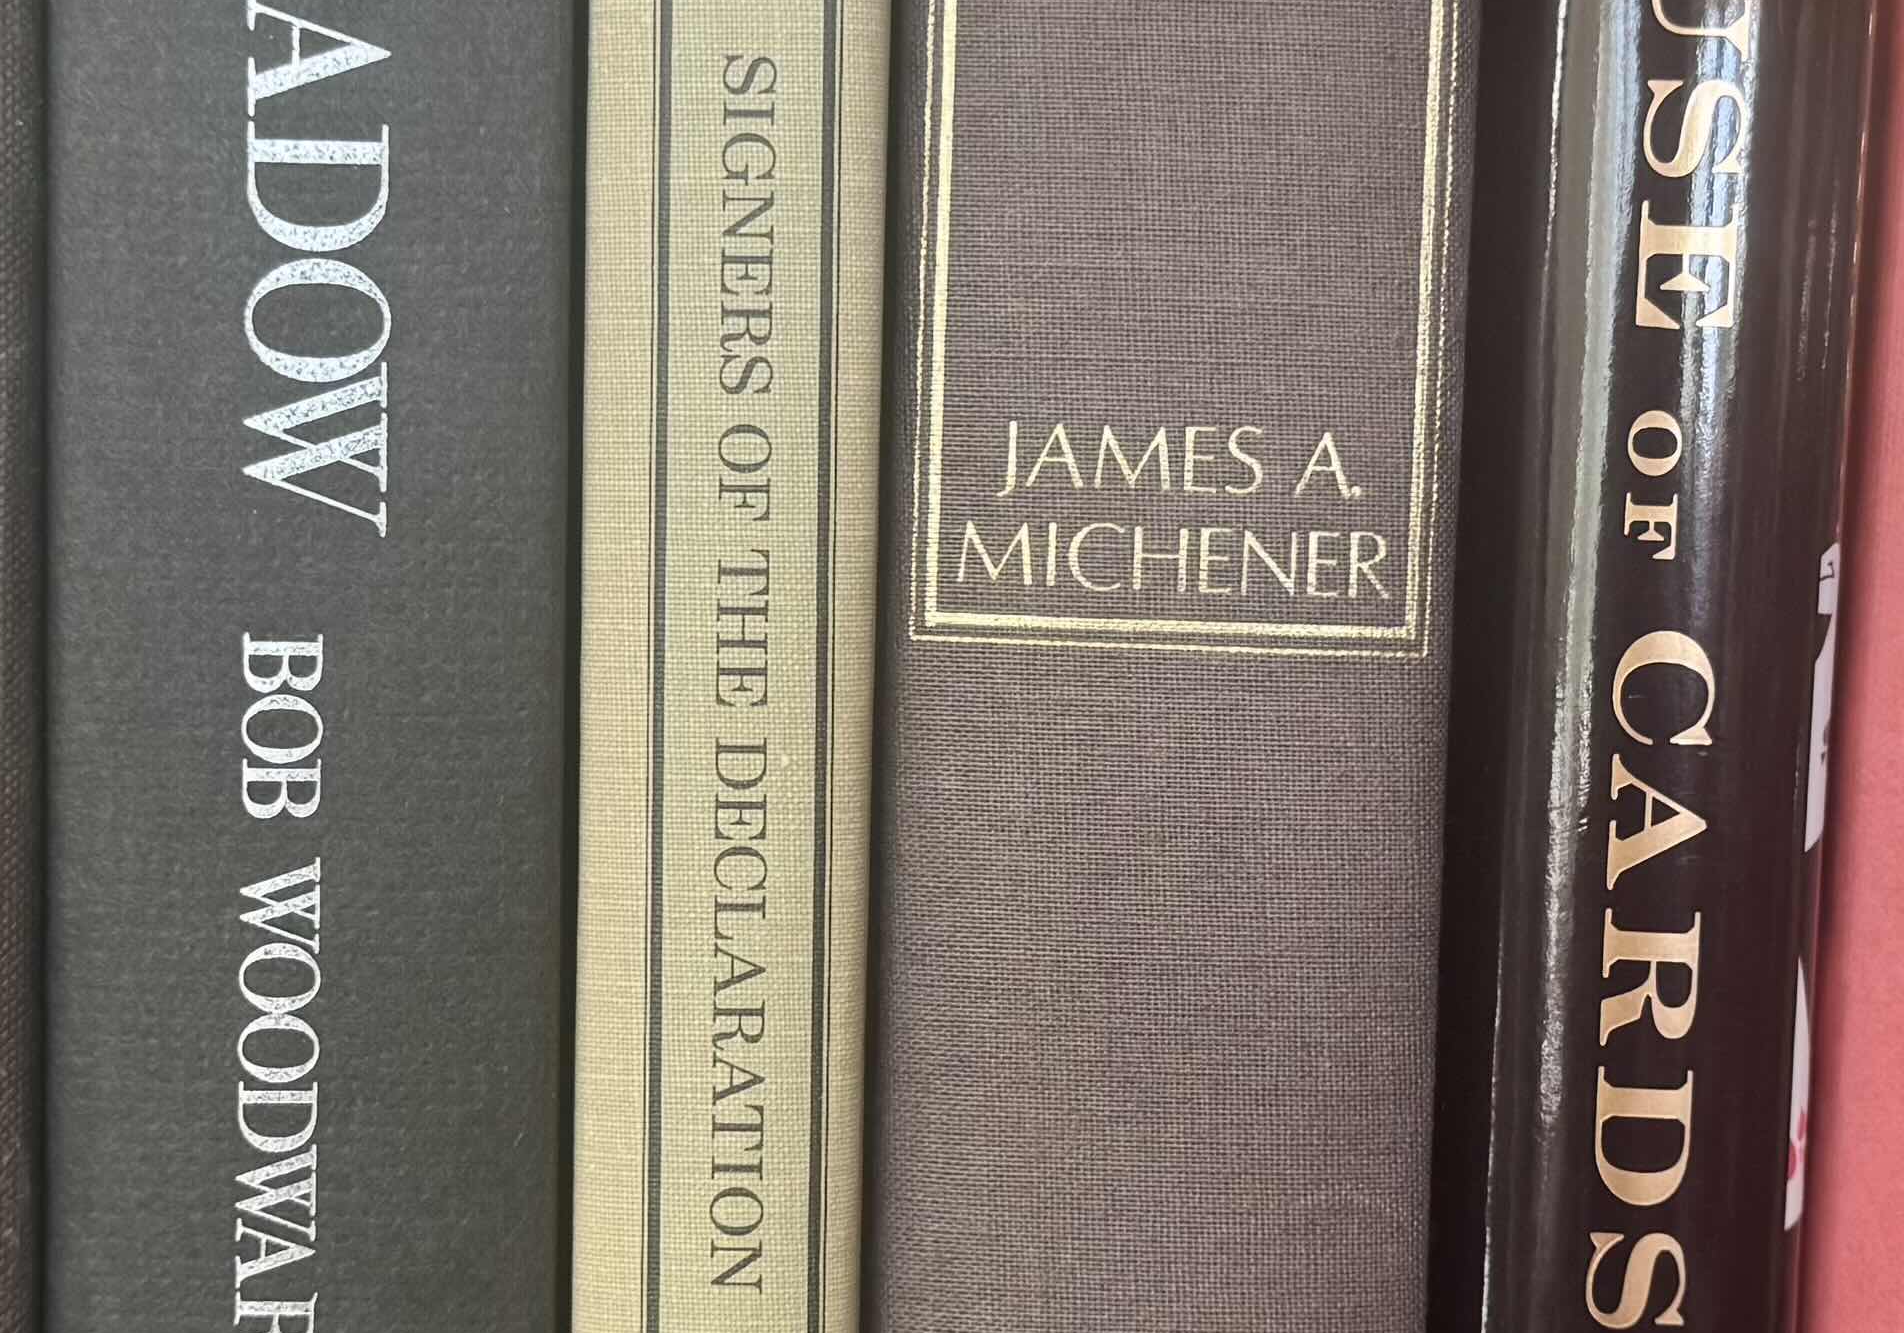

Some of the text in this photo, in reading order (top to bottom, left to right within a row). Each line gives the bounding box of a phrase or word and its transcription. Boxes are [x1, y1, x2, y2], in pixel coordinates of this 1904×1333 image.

[997, 420, 1362, 501] JAMES A.
[1623, 409, 1683, 561] OF
[956, 520, 1391, 599] MICHENER
[239, 631, 325, 820] BOB
[709, 52, 778, 1295] SIGNERS OF THE DECLARATION
[1585, 629, 1717, 1331] CARDS
